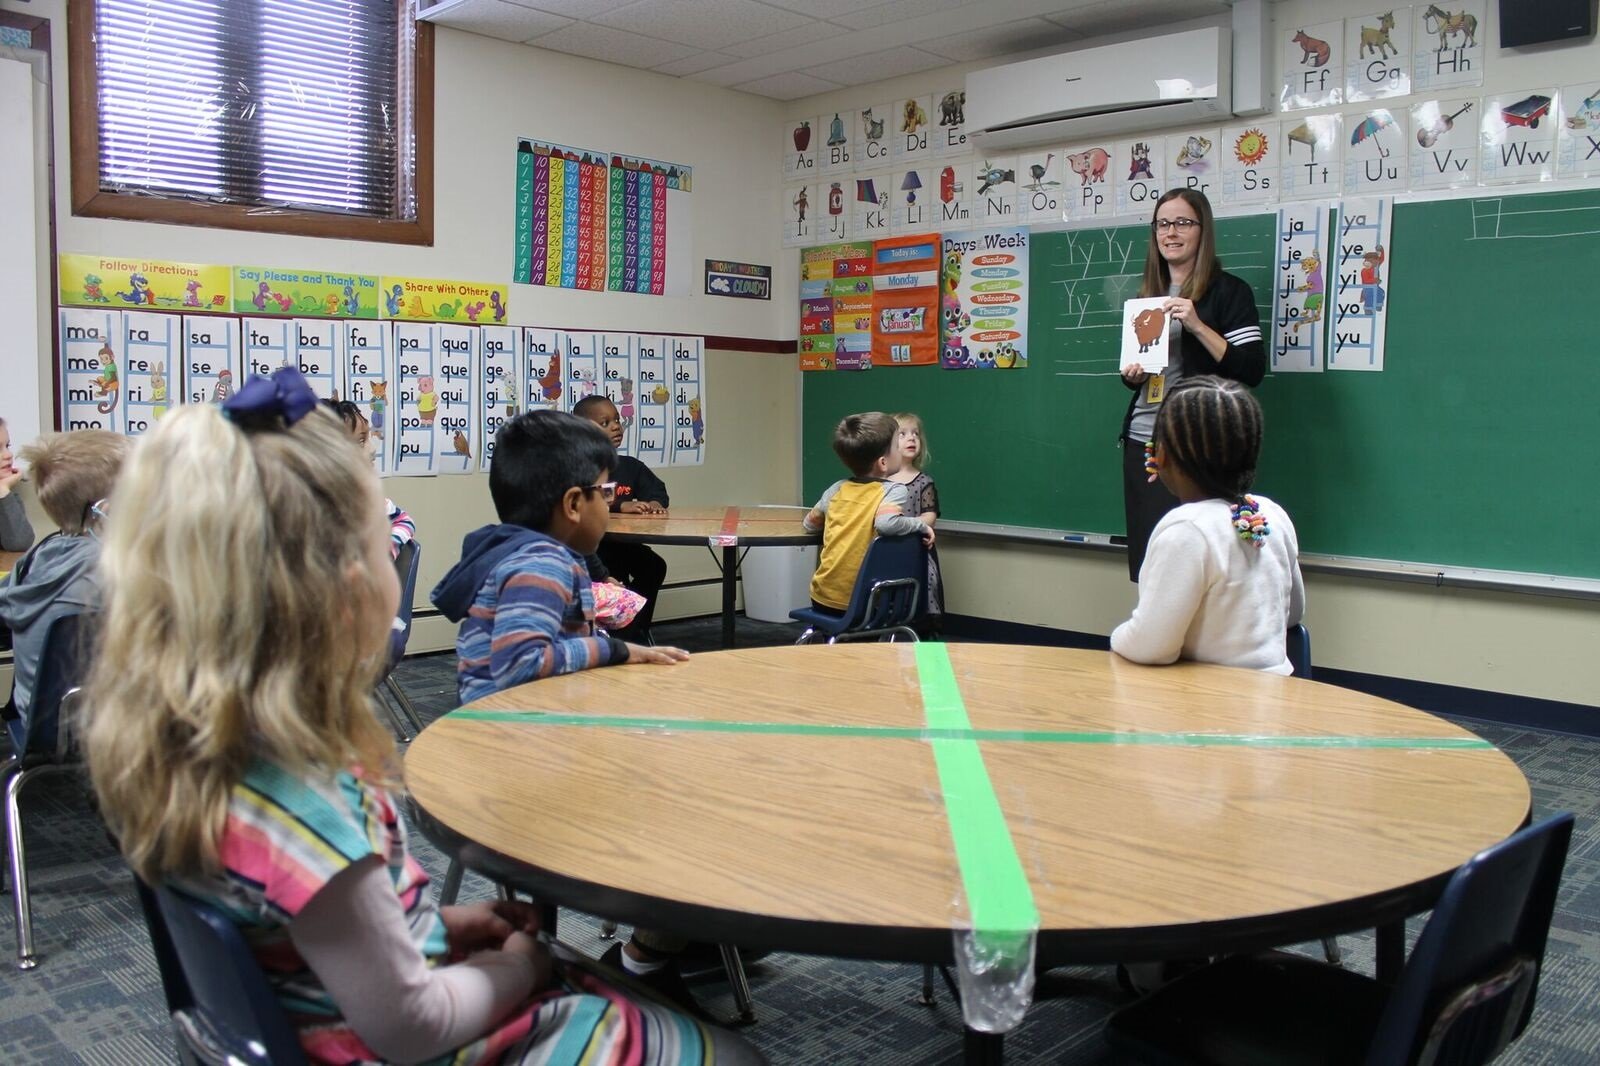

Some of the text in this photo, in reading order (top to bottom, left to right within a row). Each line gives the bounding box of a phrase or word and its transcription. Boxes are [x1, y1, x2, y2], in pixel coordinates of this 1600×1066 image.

[1436, 49, 1471, 75] Hh
[1304, 69, 1330, 93] Ff
[1366, 60, 1400, 89] Gg
[907, 132, 927, 151] Dd
[947, 128, 966, 146] Ee
[831, 147, 849, 164] Bb
[867, 142, 887, 158] Cc
[1501, 142, 1550, 167] Ww
[536, 157, 548, 168] 10
[796, 154, 813, 170] Aa
[1433, 149, 1468, 173] Vv
[536, 170, 547, 180] 11
[625, 170, 637, 182] 70
[1304, 163, 1329, 184] Tt
[1365, 159, 1397, 182] Uu
[521, 180, 529, 191] 2
[535, 182, 547, 193] 12
[627, 183, 635, 193] 71
[1243, 170, 1270, 191] Ss
[521, 193, 529, 204] 3
[535, 195, 547, 206] 13
[626, 195, 637, 206] 72
[987, 197, 1011, 215] Nn
[1031, 192, 1057, 211] Oo
[1083, 187, 1103, 213] Pp
[521, 206, 528, 216] 4
[534, 208, 546, 219] 14
[626, 207, 637, 218] 73
[908, 206, 921, 224] Ll
[943, 203, 969, 220] Mm
[520, 219, 528, 230] 5
[534, 221, 546, 232] 15
[626, 219, 637, 230] 74
[797, 220, 808, 236] Ii
[830, 216, 845, 239] Jj
[866, 211, 885, 229] Kk
[1344, 215, 1366, 236] ya
[520, 232, 528, 243] 6
[625, 231, 637, 242] 75
[1283, 218, 1304, 242] ja
[534, 234, 545, 245] 16
[944, 239, 976, 255] Days
[984, 233, 1026, 249] Week
[533, 246, 545, 258] 17
[626, 243, 637, 254] 76
[892, 250, 908, 258] Today
[1341, 244, 1363, 265] ye
[533, 259, 544, 271] 18
[626, 256, 637, 267] 77
[981, 256, 1007, 264] Sunday
[1282, 247, 1302, 270] je
[100, 260, 198, 277] Follow Directions
[625, 268, 636, 279] 78
[855, 264, 866, 272] July
[981, 269, 1008, 277] Monday
[240, 270, 375, 287] Say Please and Thank You
[532, 272, 544, 283] 19
[624, 280, 635, 291] 79
[888, 274, 918, 287] Monday
[1339, 270, 1357, 294] yi
[405, 282, 489, 297] Share With Others
[733, 279, 766, 295] CLOUDY
[1280, 275, 1294, 299] ji
[976, 294, 1015, 303] Wednesday
[1279, 303, 1299, 327] jo
[1338, 303, 1360, 324] yo
[67, 327, 98, 339] ma
[803, 324, 815, 332] April
[886, 319, 916, 331] January
[129, 329, 149, 341] ra
[191, 333, 211, 345] sa
[250, 330, 269, 346] ta
[299, 326, 320, 347] ba
[351, 328, 367, 347] fa
[980, 332, 1010, 341] Saturday
[1336, 333, 1360, 353] yu
[400, 338, 419, 356] pa
[442, 339, 468, 357] qua
[486, 341, 503, 358] ga
[530, 335, 546, 353] ha
[569, 338, 580, 355] la
[605, 346, 619, 355] ca
[640, 347, 655, 357] na
[675, 343, 689, 359] da
[1278, 332, 1298, 356] ju
[68, 358, 99, 370] me
[129, 359, 148, 371] re
[192, 361, 211, 374] se
[251, 359, 270, 375] te
[299, 354, 319, 374] be
[352, 355, 367, 374] fe
[530, 360, 545, 377] he
[569, 363, 580, 379] le
[605, 363, 618, 379] ke
[400, 365, 419, 383] pe
[441, 365, 467, 384] que
[486, 366, 503, 384] ge
[640, 371, 655, 380] ne
[676, 366, 690, 381] de
[69, 385, 93, 401] mi
[129, 386, 141, 401] ri
[193, 389, 205, 403] si
[352, 382, 363, 401] fi
[401, 388, 414, 409] pi
[441, 389, 463, 409] qui
[487, 388, 499, 409] gi
[529, 384, 541, 402] hi
[570, 386, 576, 403] li
[641, 393, 650, 404] ni
[676, 389, 687, 404] di
[70, 420, 101, 430] mo
[128, 420, 147, 431] ro
[401, 418, 419, 435] po
[441, 417, 467, 435] quo
[487, 417, 503, 434] go
[641, 416, 655, 426] no
[677, 411, 691, 426] do
[640, 439, 655, 449] nu
[677, 433, 691, 448] du
[400, 443, 419, 462] pu
